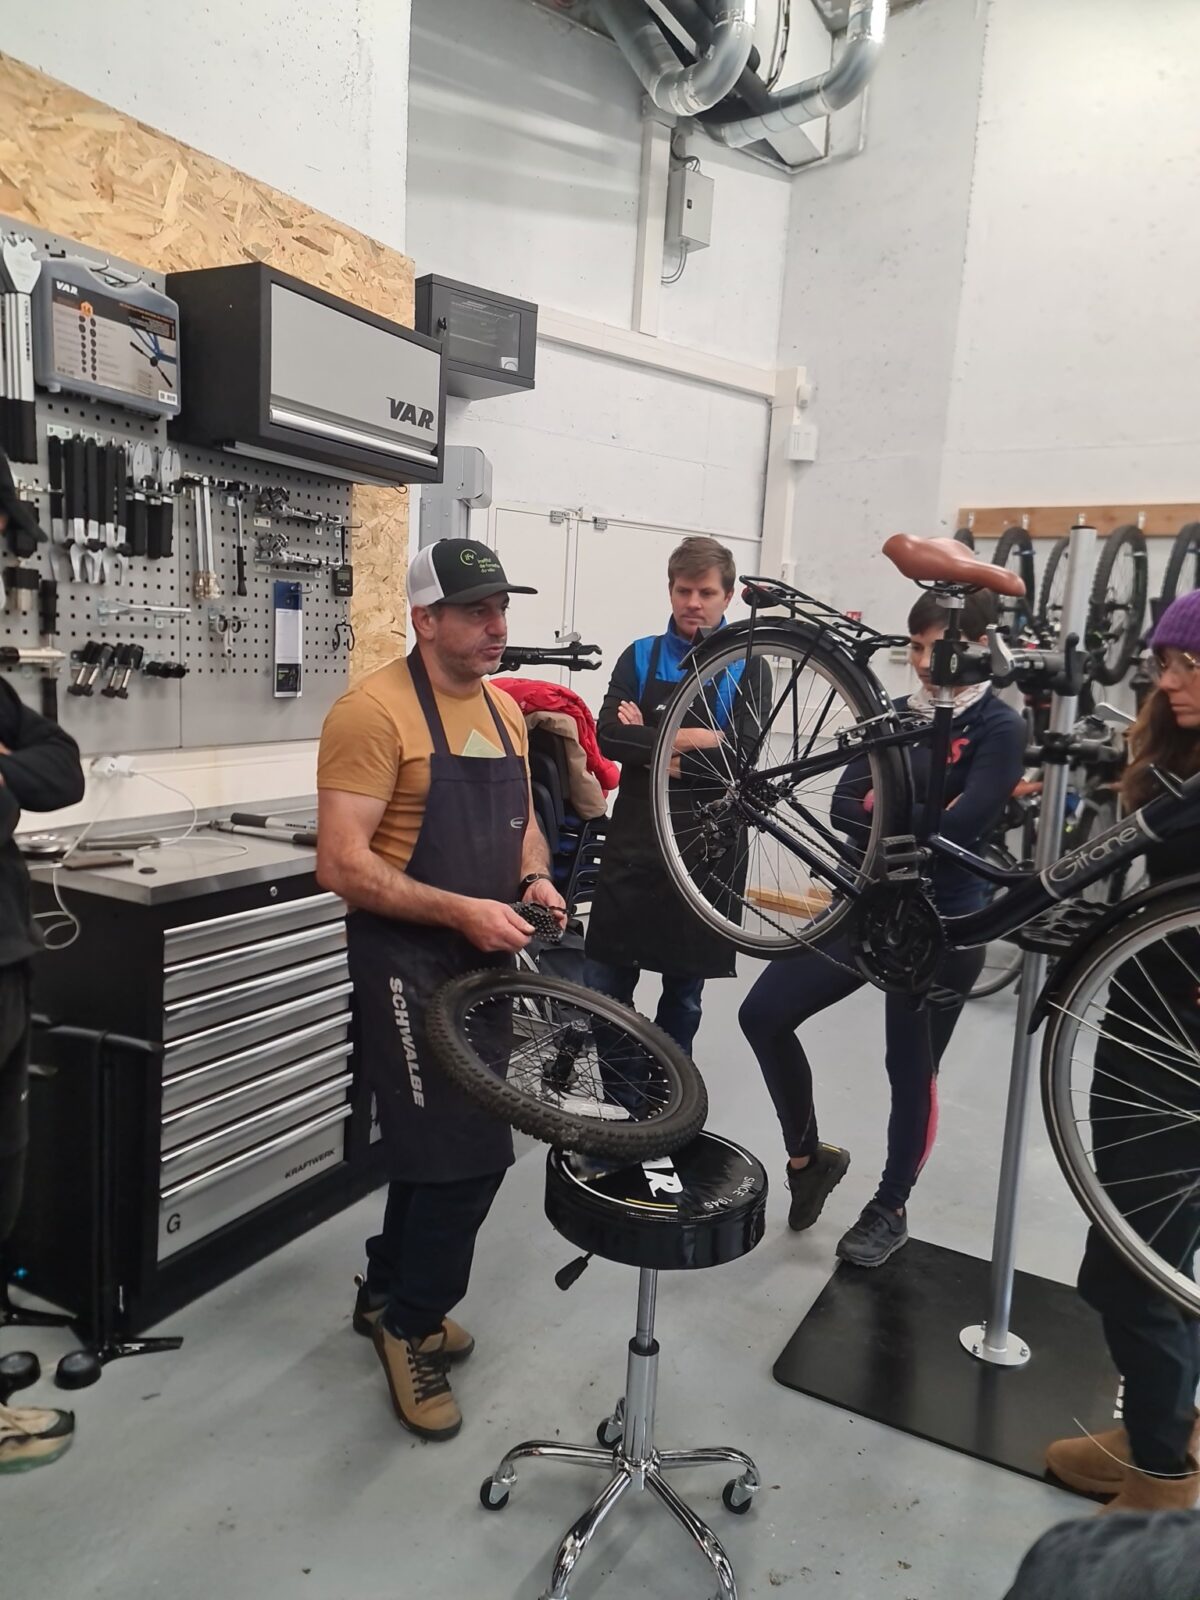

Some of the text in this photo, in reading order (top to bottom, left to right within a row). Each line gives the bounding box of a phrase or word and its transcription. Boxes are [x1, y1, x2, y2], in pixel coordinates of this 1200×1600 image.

[56, 280, 79, 296] VAR
[386, 396, 434, 431] VAR
[1049, 827, 1137, 882] Gitane
[389, 976, 425, 1108] SCHWALBE
[285, 1148, 335, 1179] KRAFTWERK
[703, 1176, 755, 1209] SINCE 1945
[167, 1212, 181, 1234] G
